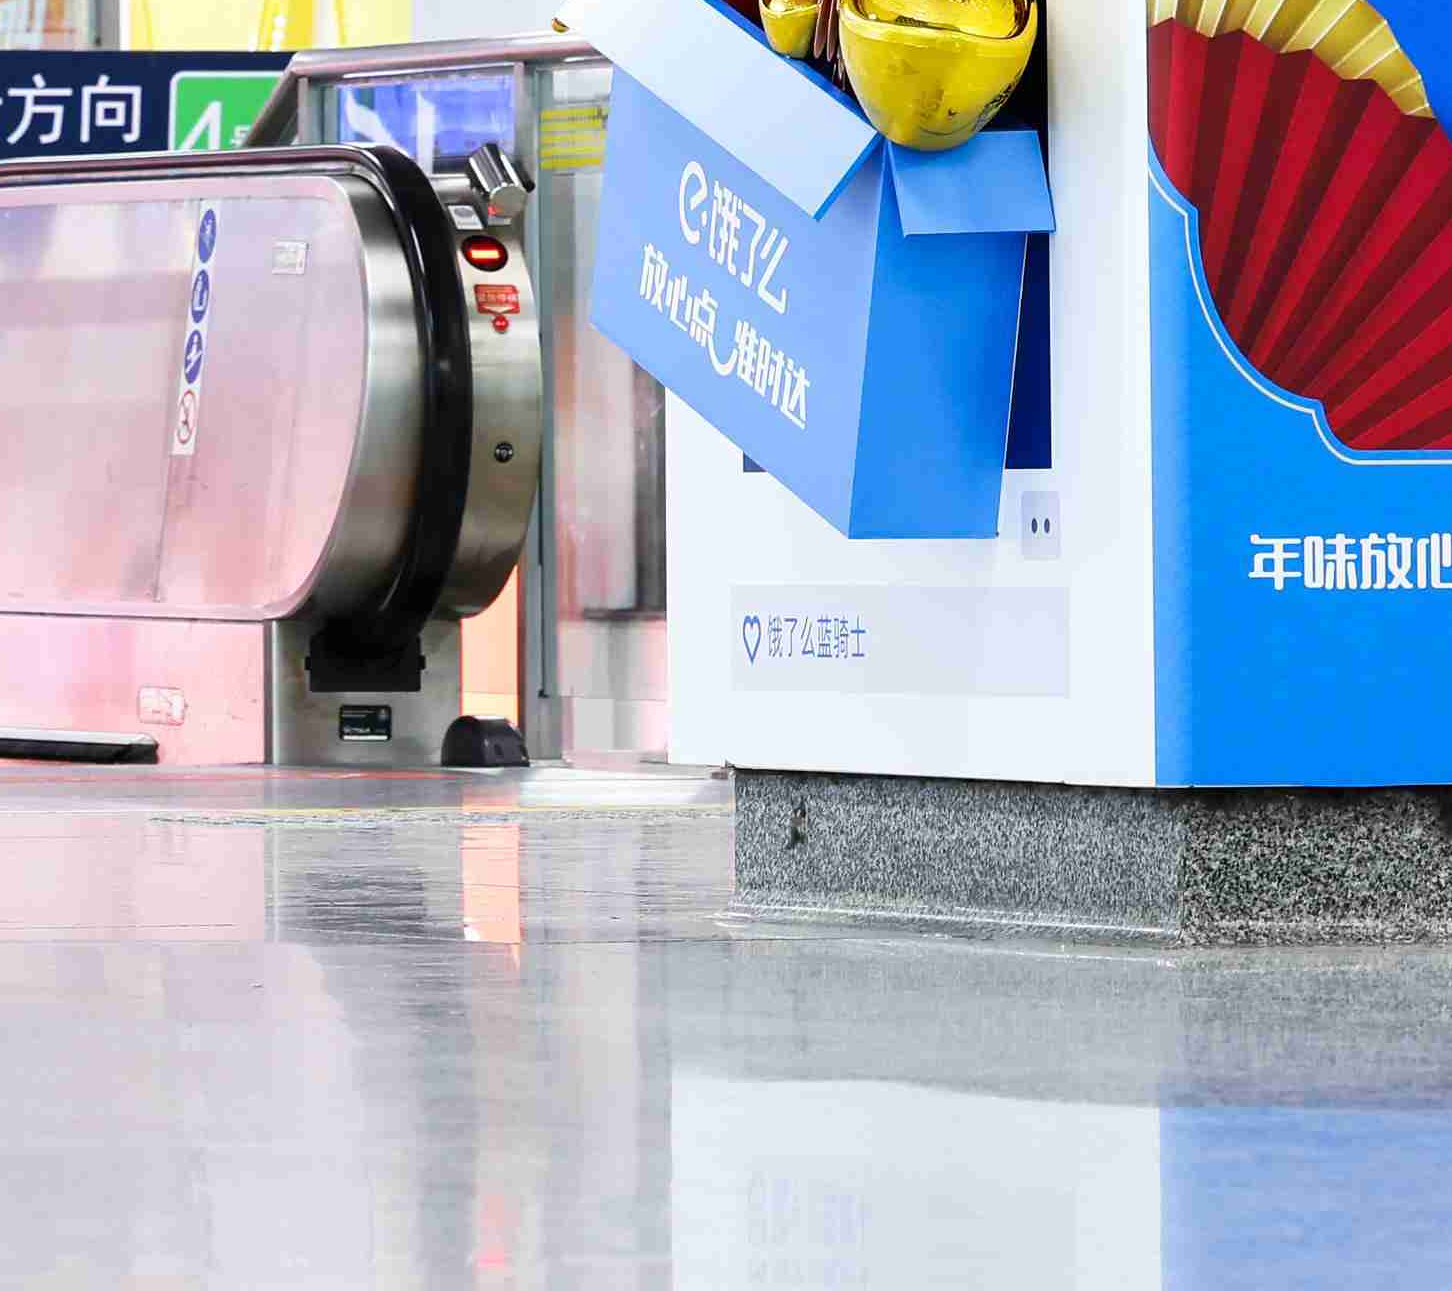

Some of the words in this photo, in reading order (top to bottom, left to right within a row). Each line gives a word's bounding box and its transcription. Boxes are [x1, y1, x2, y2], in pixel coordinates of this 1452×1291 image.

[766, 613, 867, 661] 饿了么蓝骑士
